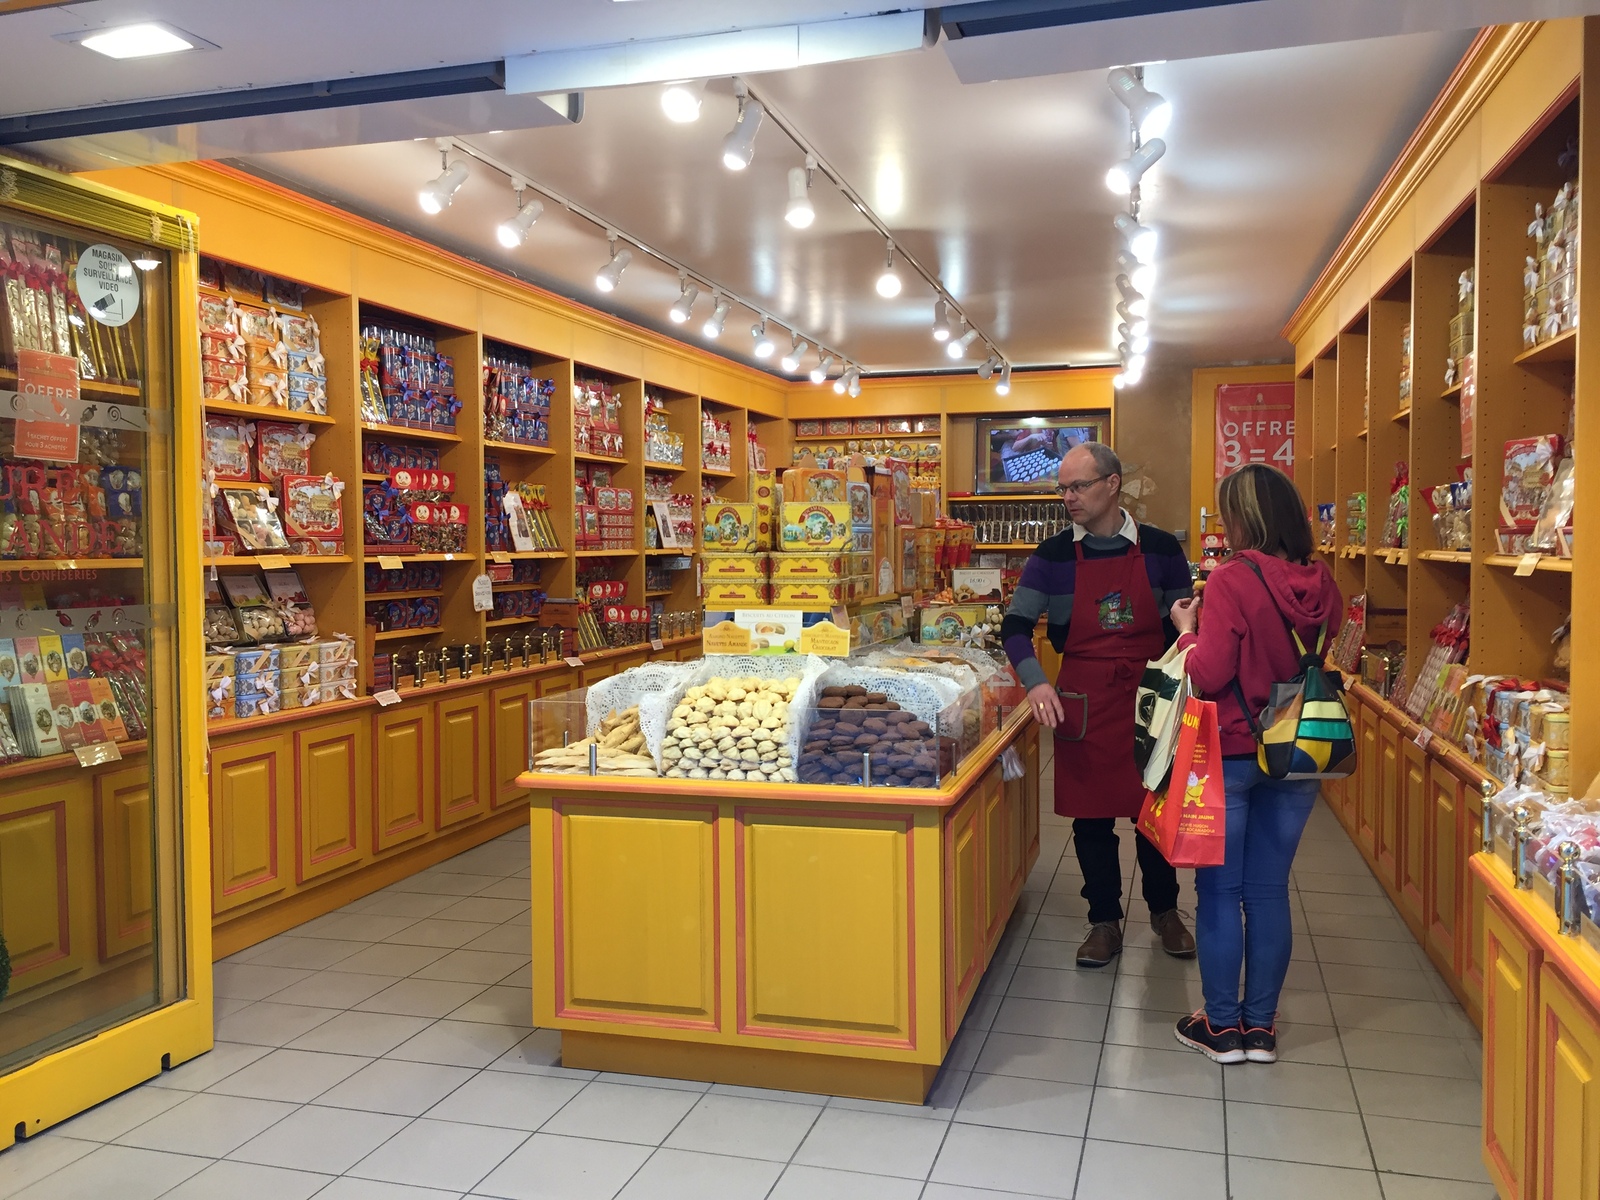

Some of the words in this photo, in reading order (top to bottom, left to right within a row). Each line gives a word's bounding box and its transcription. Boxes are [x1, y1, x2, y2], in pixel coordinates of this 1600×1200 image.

[91, 248, 123, 263] MAGASIN
[98, 281, 119, 293] VIDEO
[25, 383, 73, 399] OFFRE
[1223, 420, 1295, 437] OFFRE
[40, 441, 44, 449] 3
